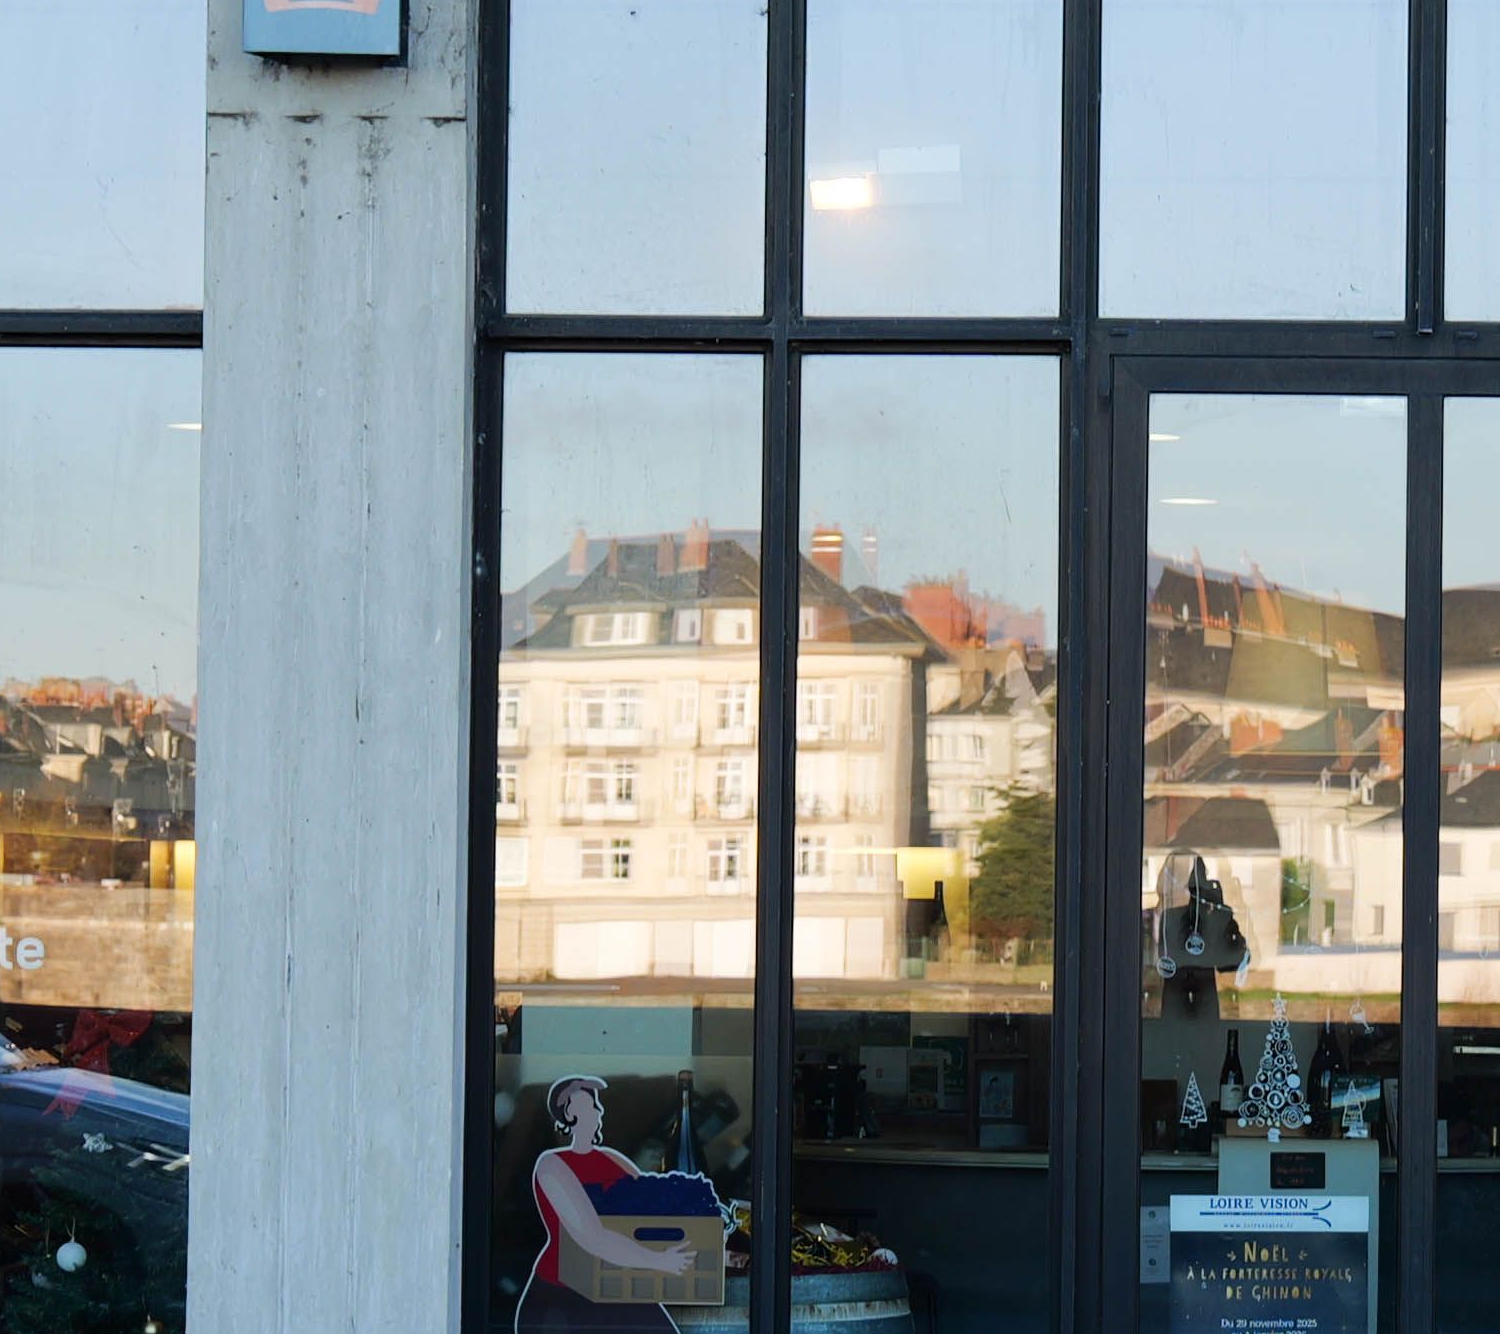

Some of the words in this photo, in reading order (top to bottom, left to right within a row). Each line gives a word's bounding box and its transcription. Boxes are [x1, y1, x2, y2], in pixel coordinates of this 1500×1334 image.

[1210, 1197, 1254, 1209] LOIRE
[1259, 1197, 1309, 1209] VISION
[1222, 1267, 1298, 1280] FORTERESSE
[1225, 1285, 1243, 1299] DE
[1220, 1318, 1235, 1328] Du
[1249, 1318, 1294, 1328] novembre
